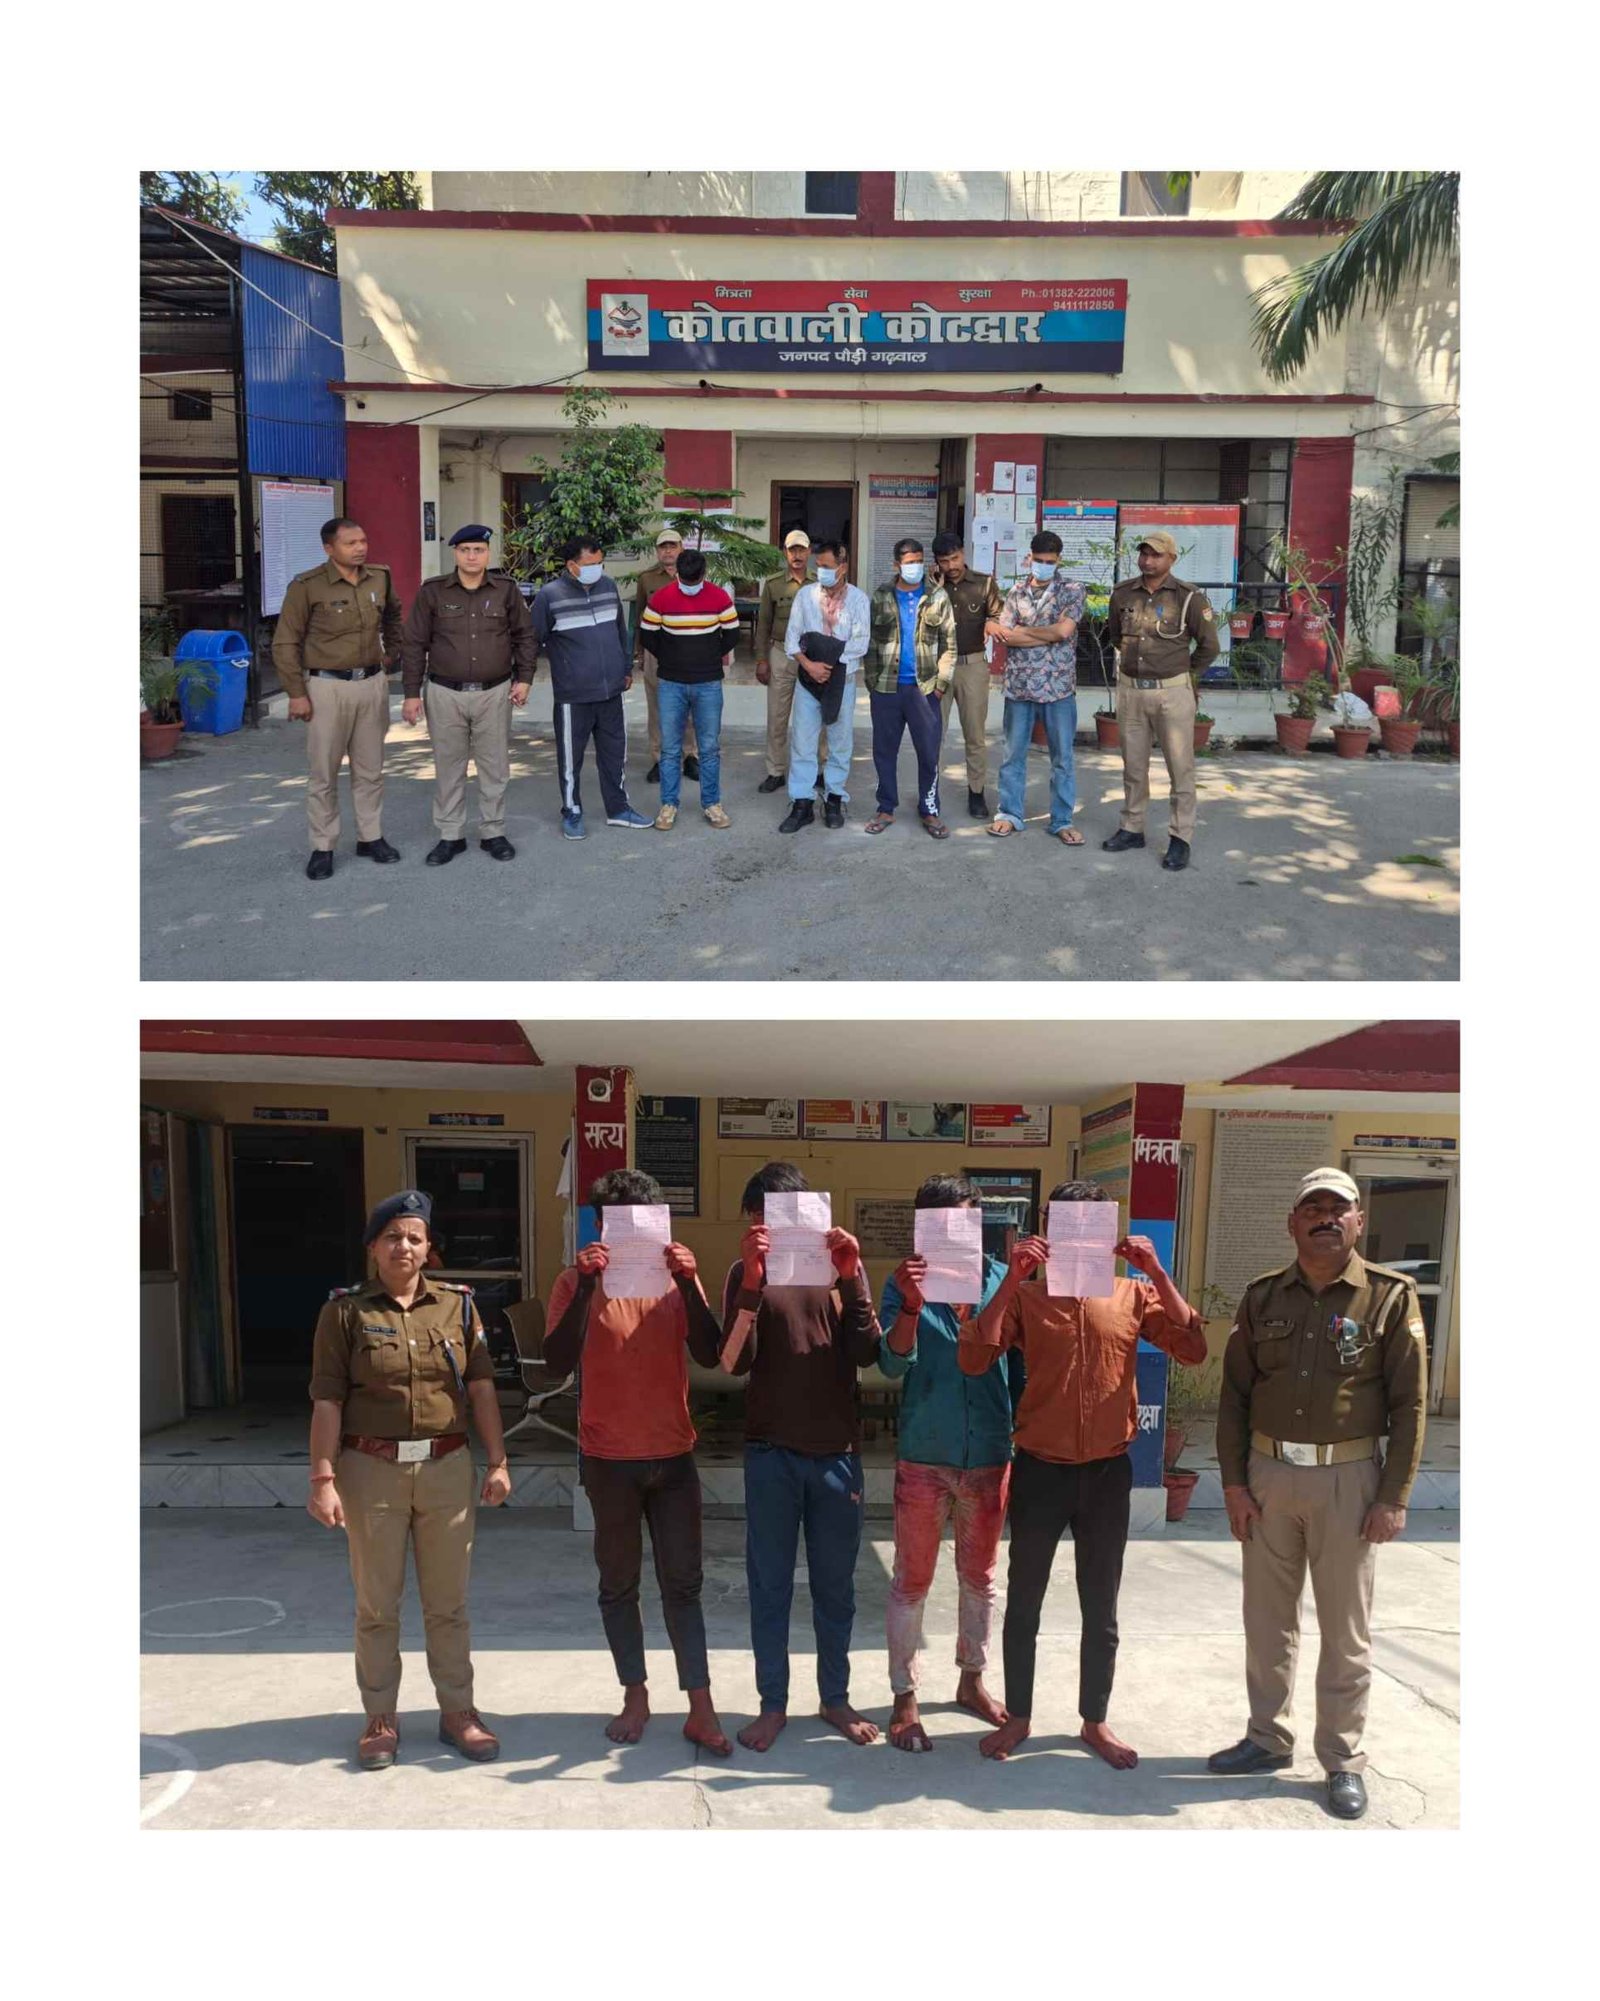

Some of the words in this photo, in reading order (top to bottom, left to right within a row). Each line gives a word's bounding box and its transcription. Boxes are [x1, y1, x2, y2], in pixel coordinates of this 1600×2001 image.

[715, 286, 752, 298] मित्रता
[844, 287, 868, 298] सेवा
[959, 289, 992, 302] सुरक्षा
[1054, 300, 1115, 311] 9411112850
[661, 301, 868, 343] कोतवाली
[881, 302, 1046, 343] कोटद्वार
[779, 351, 829, 362] जनपद
[835, 348, 867, 365] पौड़ी
[871, 351, 927, 365] गढ़वाल
[584, 1122, 625, 1149] सत्य
[1132, 1134, 1181, 1165] मित्रता
[1136, 1404, 1162, 1435] रक्षा
